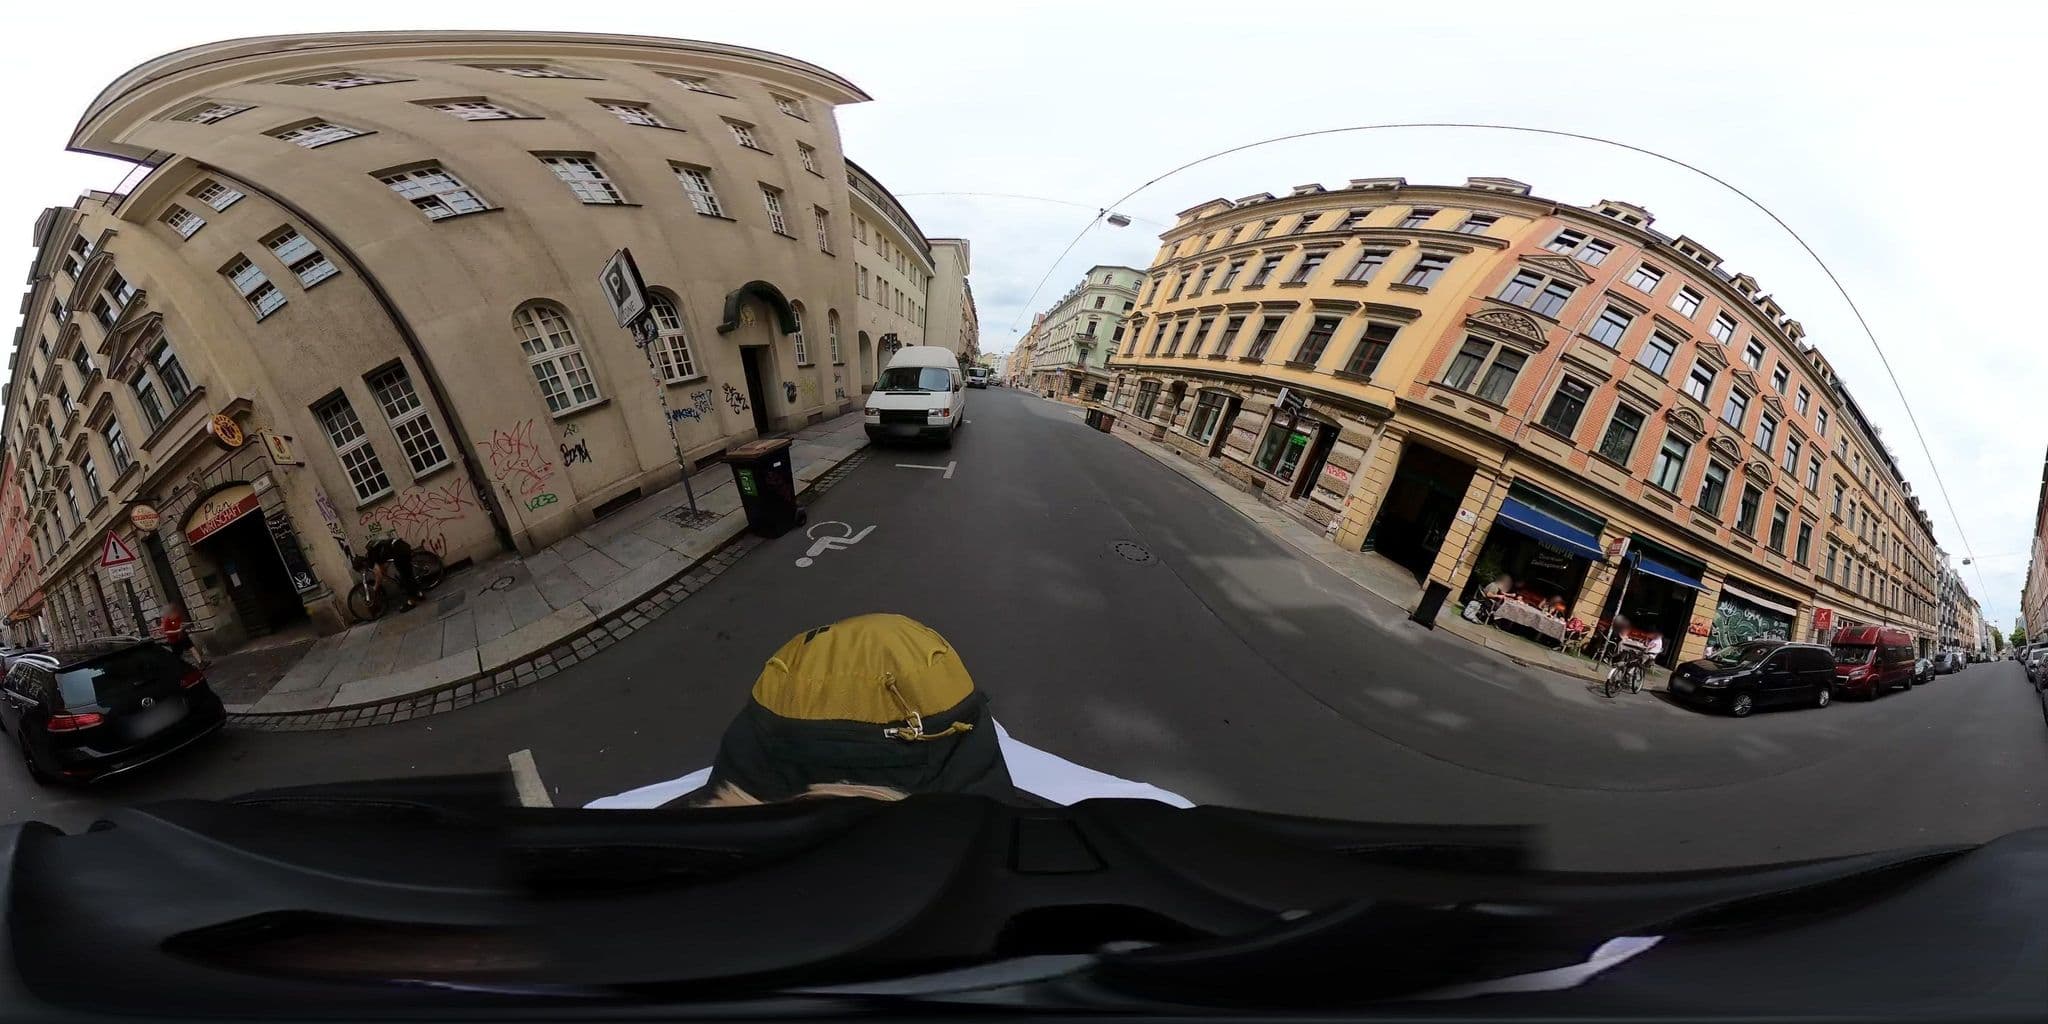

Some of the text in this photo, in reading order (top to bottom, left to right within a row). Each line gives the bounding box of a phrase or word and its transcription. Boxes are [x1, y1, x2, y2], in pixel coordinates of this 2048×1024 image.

[609, 272, 621, 300] P
[200, 505, 241, 535] WIRTSCHAFT
[204, 502, 231, 520] Plan
